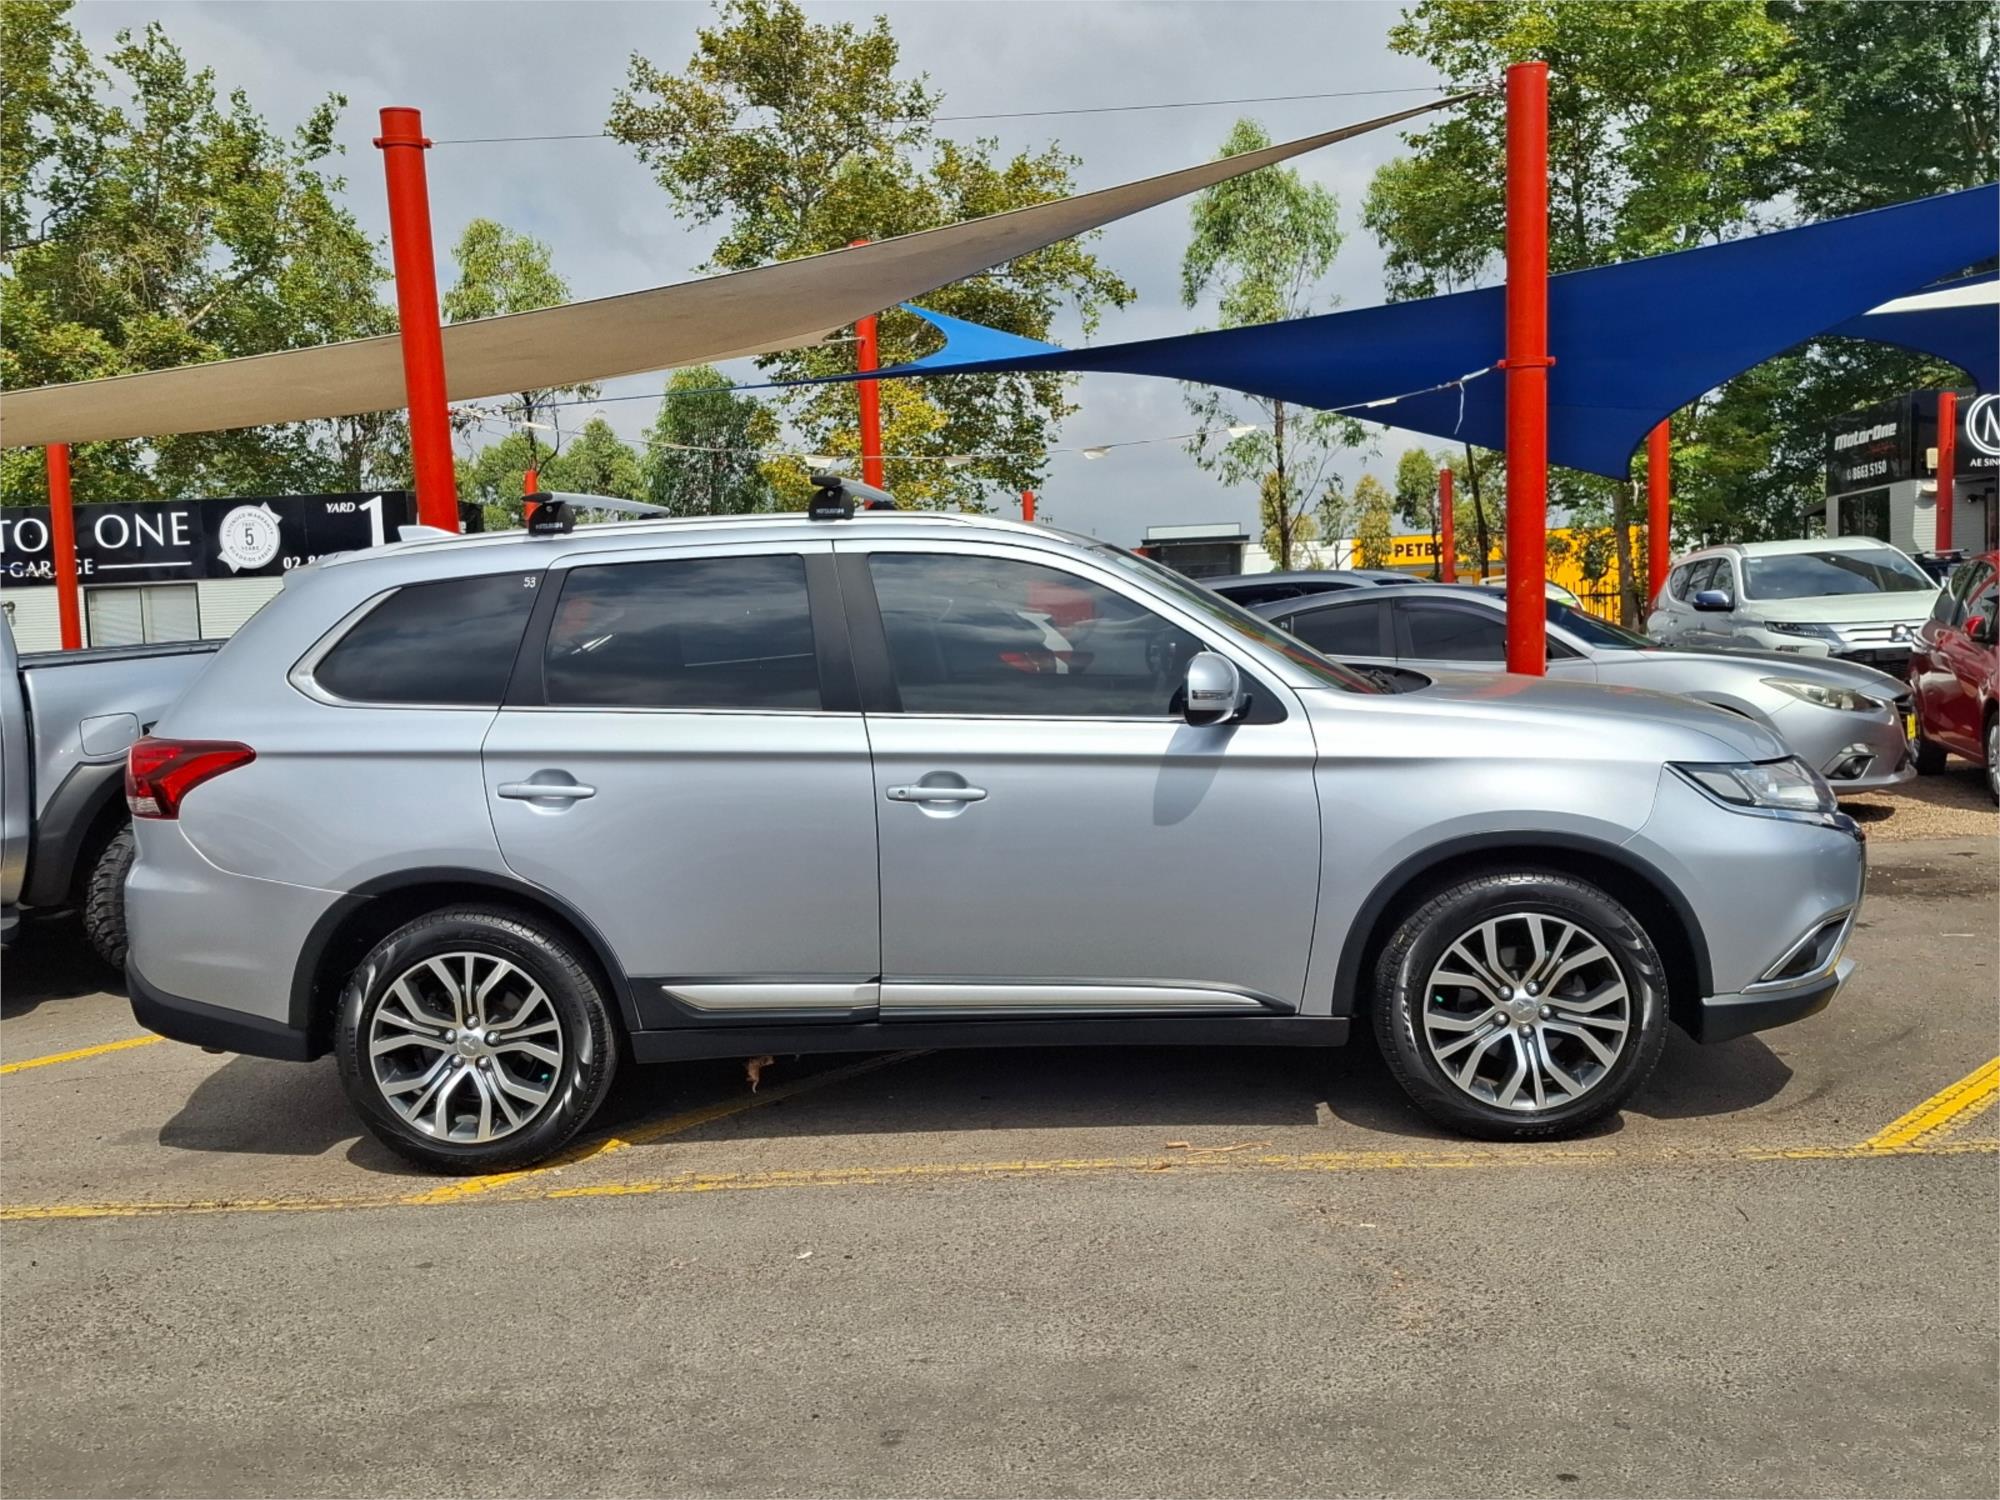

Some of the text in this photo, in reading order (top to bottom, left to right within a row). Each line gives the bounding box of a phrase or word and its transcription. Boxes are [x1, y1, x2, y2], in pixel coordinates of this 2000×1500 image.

[326, 495, 385, 548] YARD 1
[0, 511, 191, 553] TO ONE
[244, 527, 255, 546] 5
[1394, 542, 1443, 558] PETB
[283, 555, 301, 570] 02
[523, 576, 536, 589] 53
